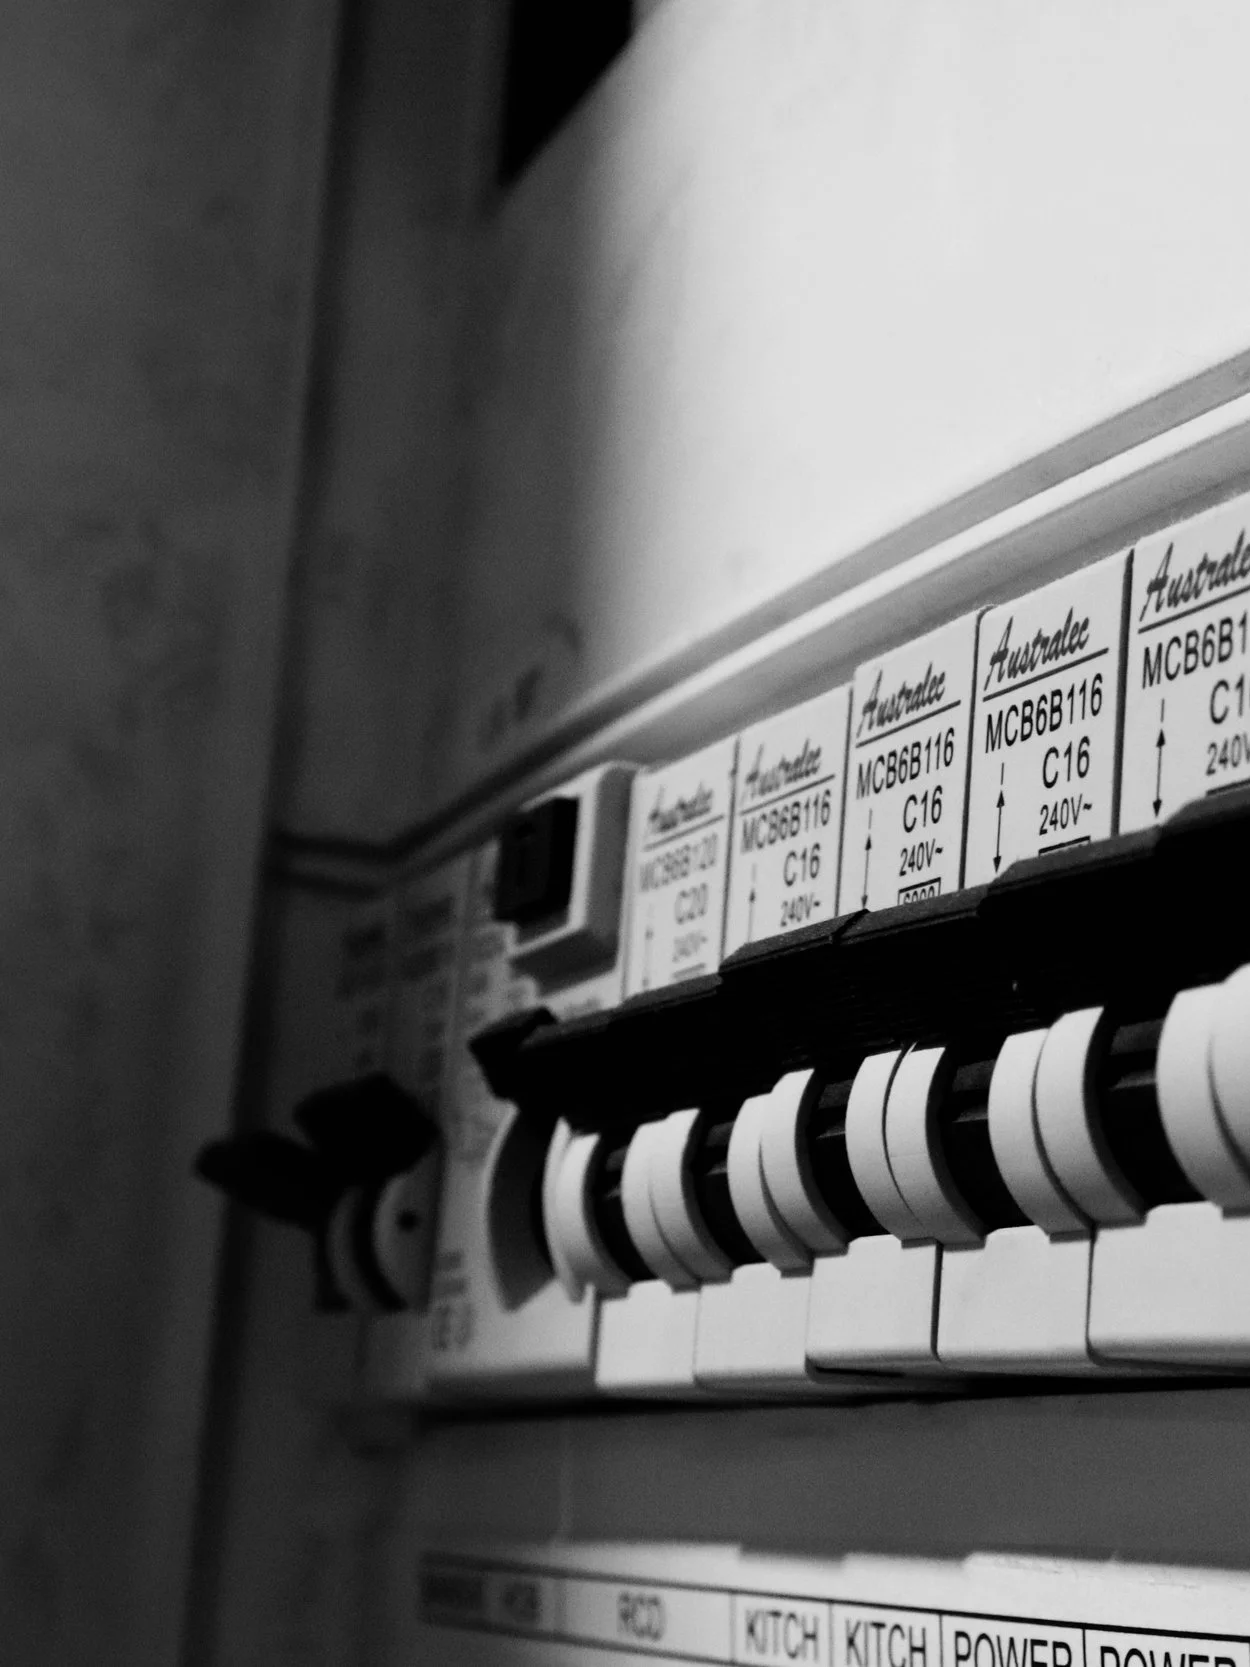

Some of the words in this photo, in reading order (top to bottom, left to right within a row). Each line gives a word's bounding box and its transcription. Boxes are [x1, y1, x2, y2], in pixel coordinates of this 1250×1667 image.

[984, 606, 1090, 691] Australec
[856, 661, 946, 739] Australec
[985, 672, 1103, 754] MCB6B116
[856, 727, 955, 800] MCB6B116
[1042, 735, 1090, 789] C16
[740, 788, 831, 854] MCB6B116
[903, 785, 943, 833] C16
[783, 842, 821, 888] C16
[617, 1590, 666, 1642] RCD
[746, 1609, 820, 1662] KITCH
[846, 1619, 926, 1667] KITCH
